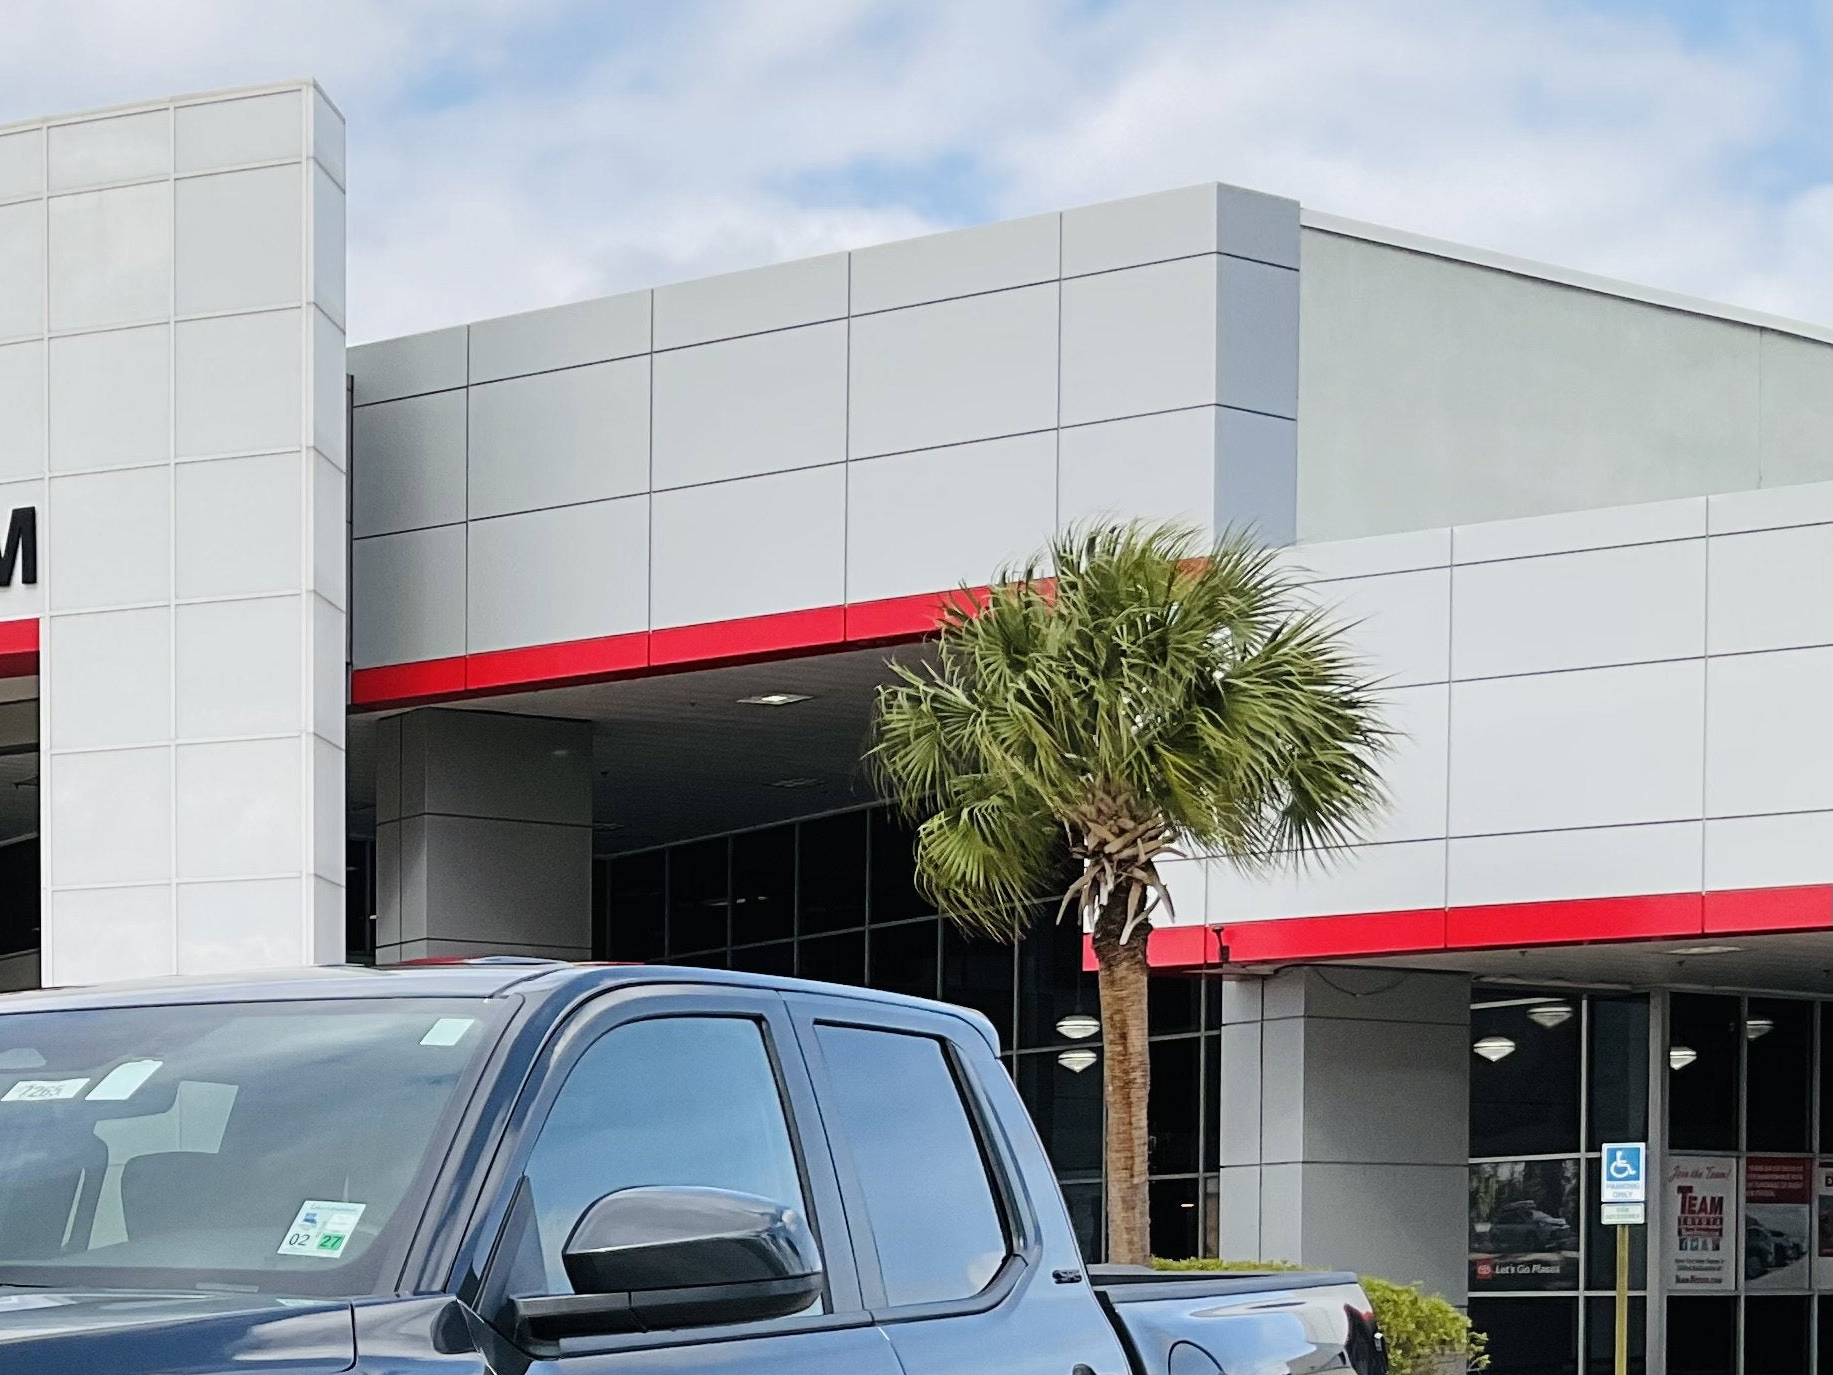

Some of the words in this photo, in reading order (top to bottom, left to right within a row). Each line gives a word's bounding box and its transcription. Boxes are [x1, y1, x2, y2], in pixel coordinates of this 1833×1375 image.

[1676, 1185, 1725, 1215] TEAM
[288, 1233, 311, 1247] 02
[318, 1235, 344, 1249] 27
[1495, 1263, 1515, 1274] Let's
[1516, 1264, 1531, 1274] Go
